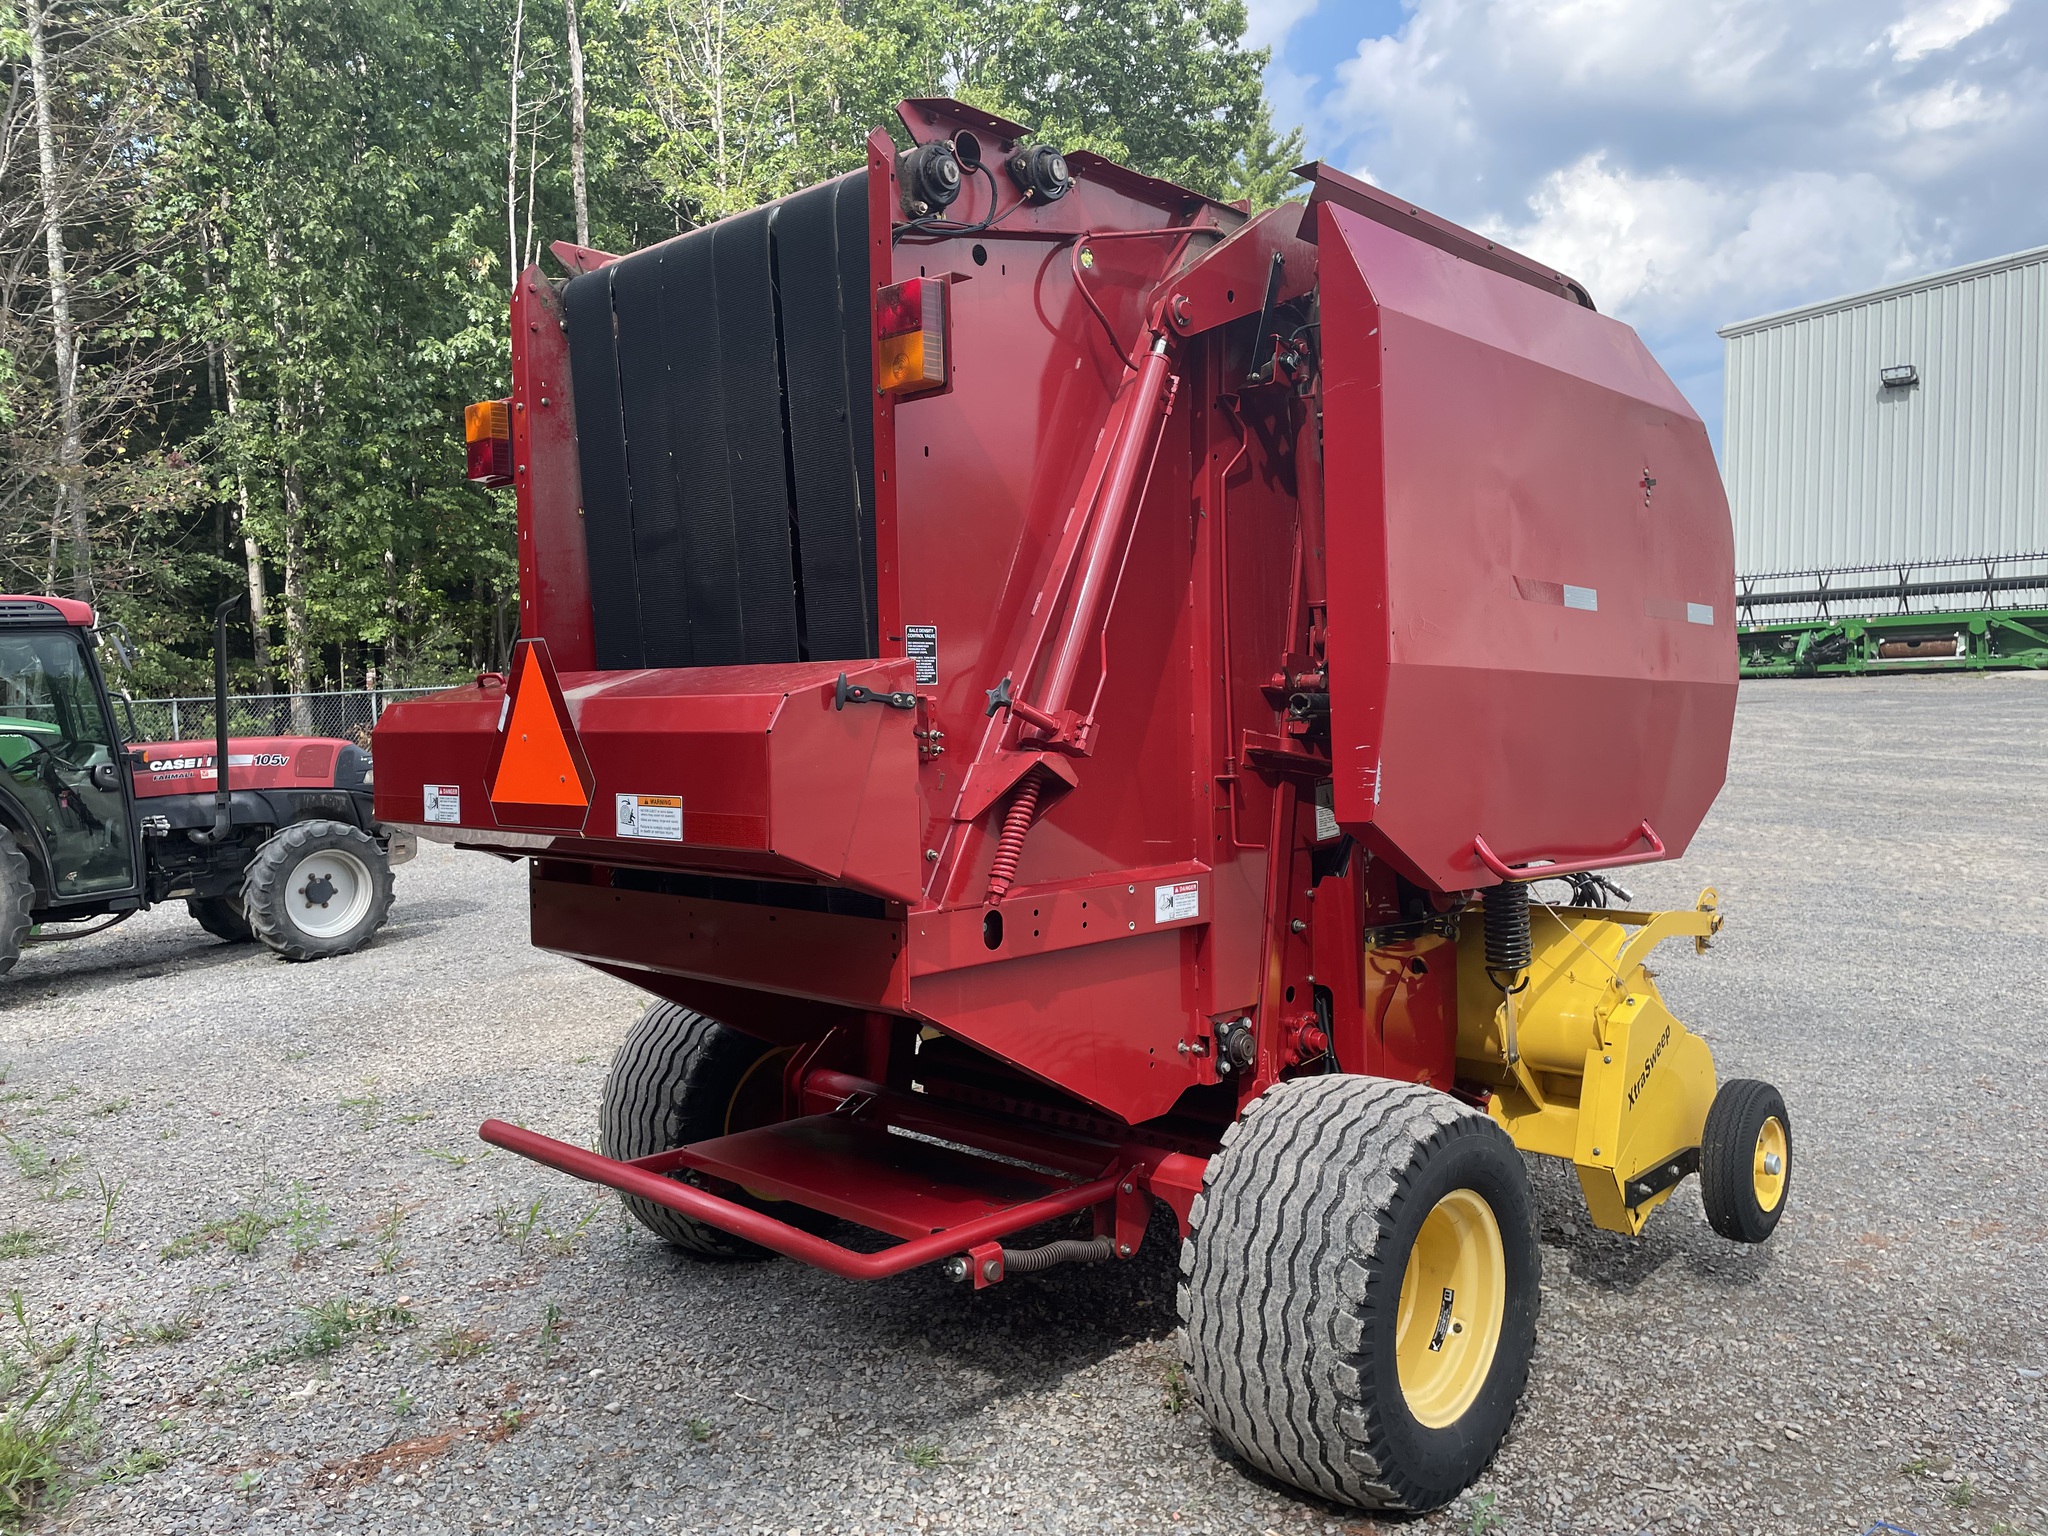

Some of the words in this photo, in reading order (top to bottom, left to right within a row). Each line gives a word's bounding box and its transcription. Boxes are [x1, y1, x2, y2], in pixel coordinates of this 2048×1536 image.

[149, 758, 195, 771] CASE
[152, 772, 195, 781] FARMALL
[1179, 884, 1197, 893] DANGER
[1627, 1024, 1671, 1112] XtraSweep
